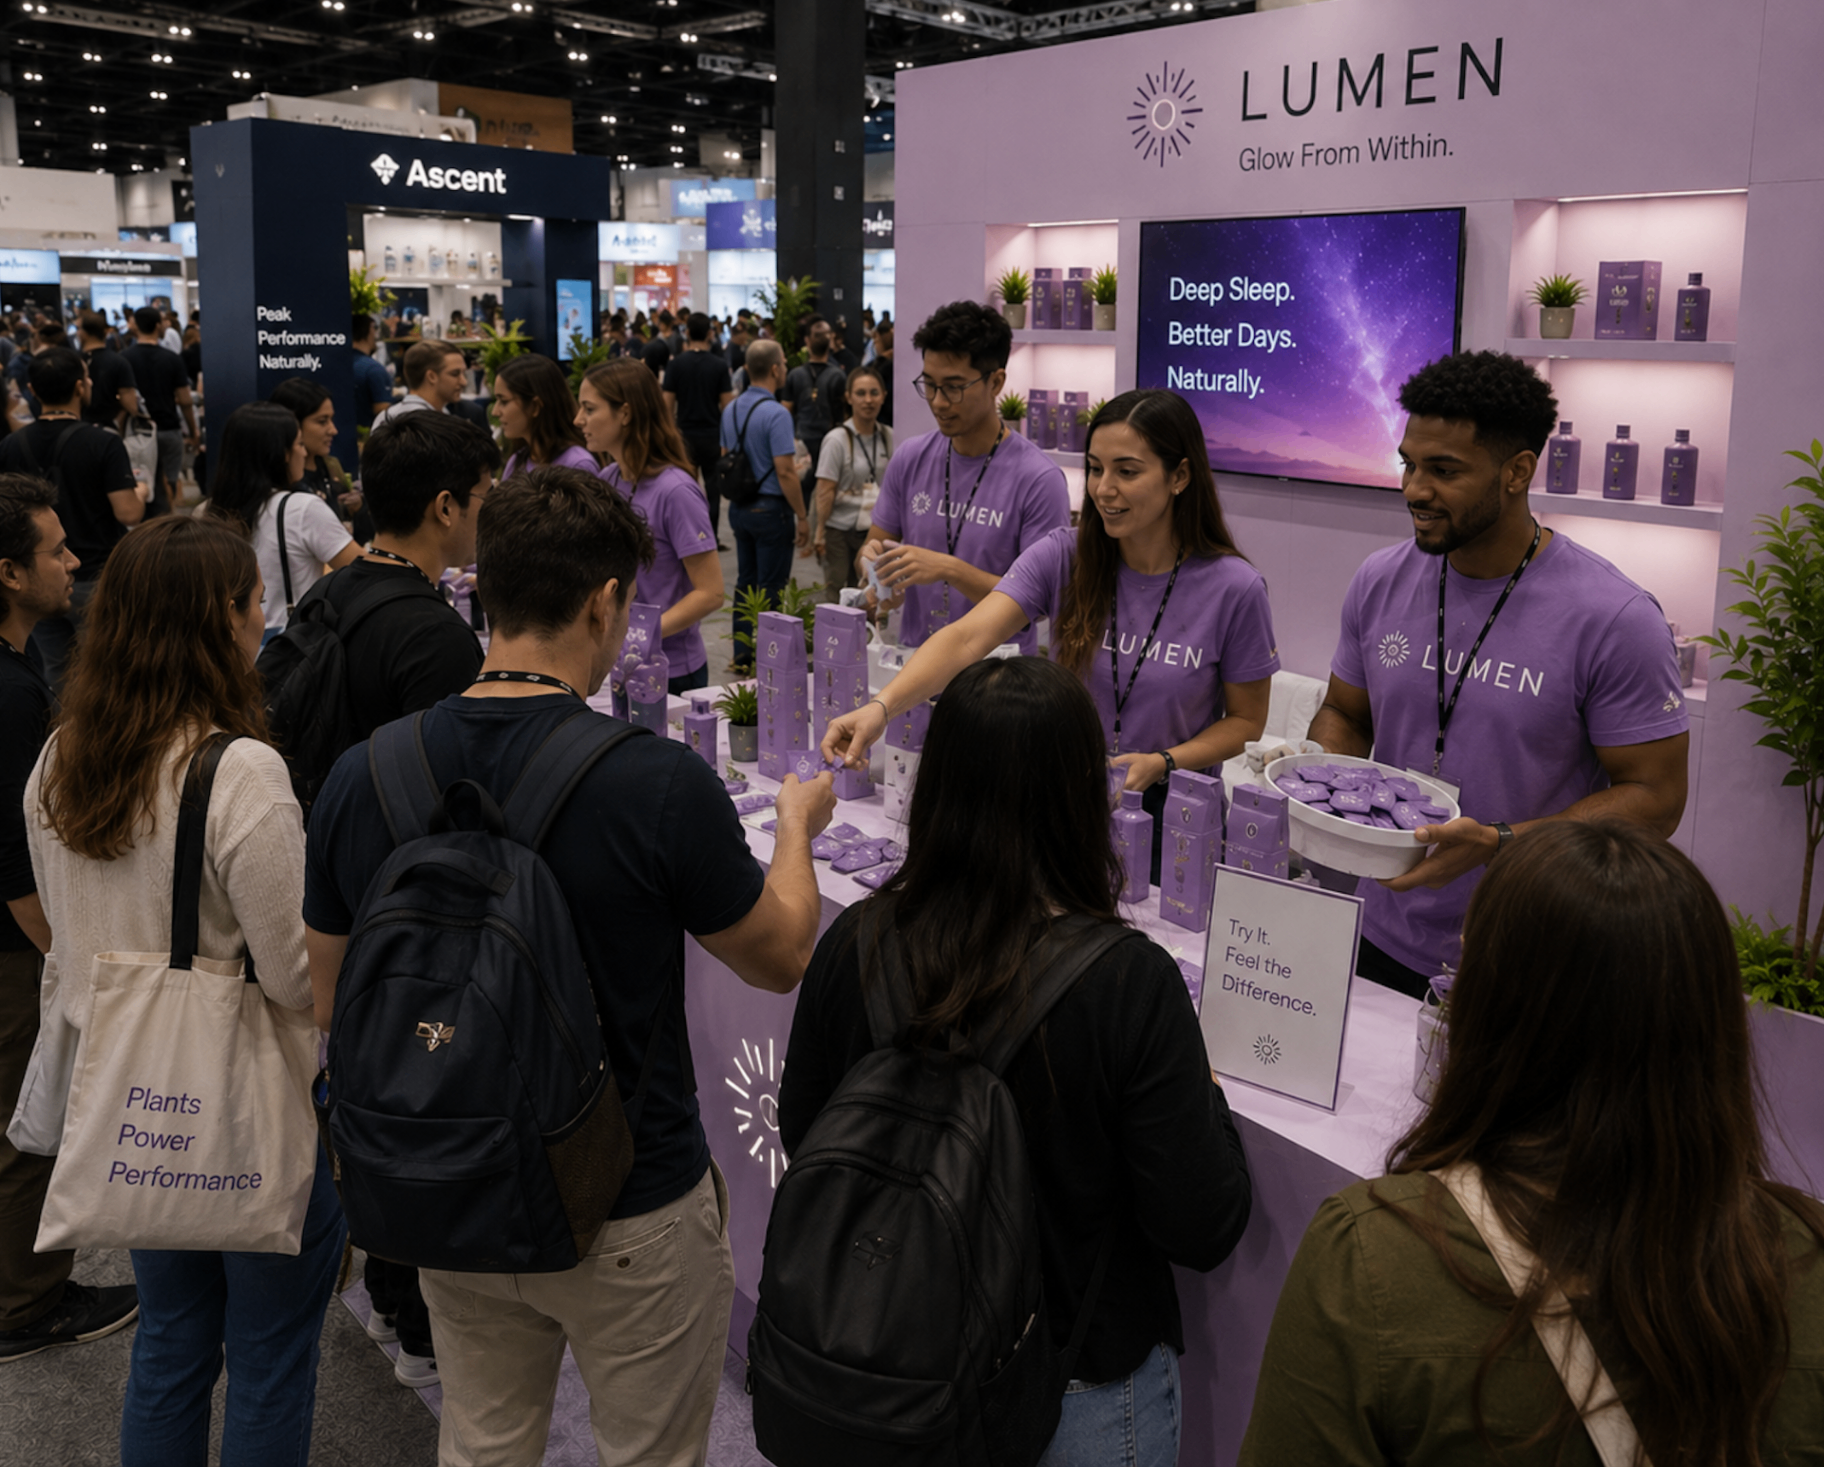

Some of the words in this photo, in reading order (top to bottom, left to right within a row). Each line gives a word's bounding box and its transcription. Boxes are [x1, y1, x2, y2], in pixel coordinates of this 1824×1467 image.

[1242, 37, 1503, 121] LUMEN
[1239, 147, 1294, 171] Glow
[1302, 142, 1360, 167] From
[1368, 133, 1454, 162] Within.
[406, 158, 507, 194] Ascent
[1170, 276, 1224, 307] Deep
[1229, 276, 1295, 307] Sleep.
[257, 305, 292, 321] Peak
[257, 330, 346, 346] Performance
[1168, 321, 1233, 346] Better
[1238, 322, 1297, 353] Days.
[259, 353, 322, 372] Naturally.
[1167, 365, 1265, 399] Naturally.
[936, 499, 1004, 528] LUMEN
[1101, 629, 1203, 669] LUMEN
[1421, 644, 1545, 697] LUMEN
[1229, 918, 1254, 944] Try
[1257, 926, 1271, 946] It.
[1225, 946, 1260, 971] Feel
[1264, 957, 1292, 979] the
[1222, 974, 1317, 1016] Difference.
[126, 1086, 202, 1115] Plants
[118, 1123, 195, 1152] Power
[108, 1160, 263, 1191] Performance
